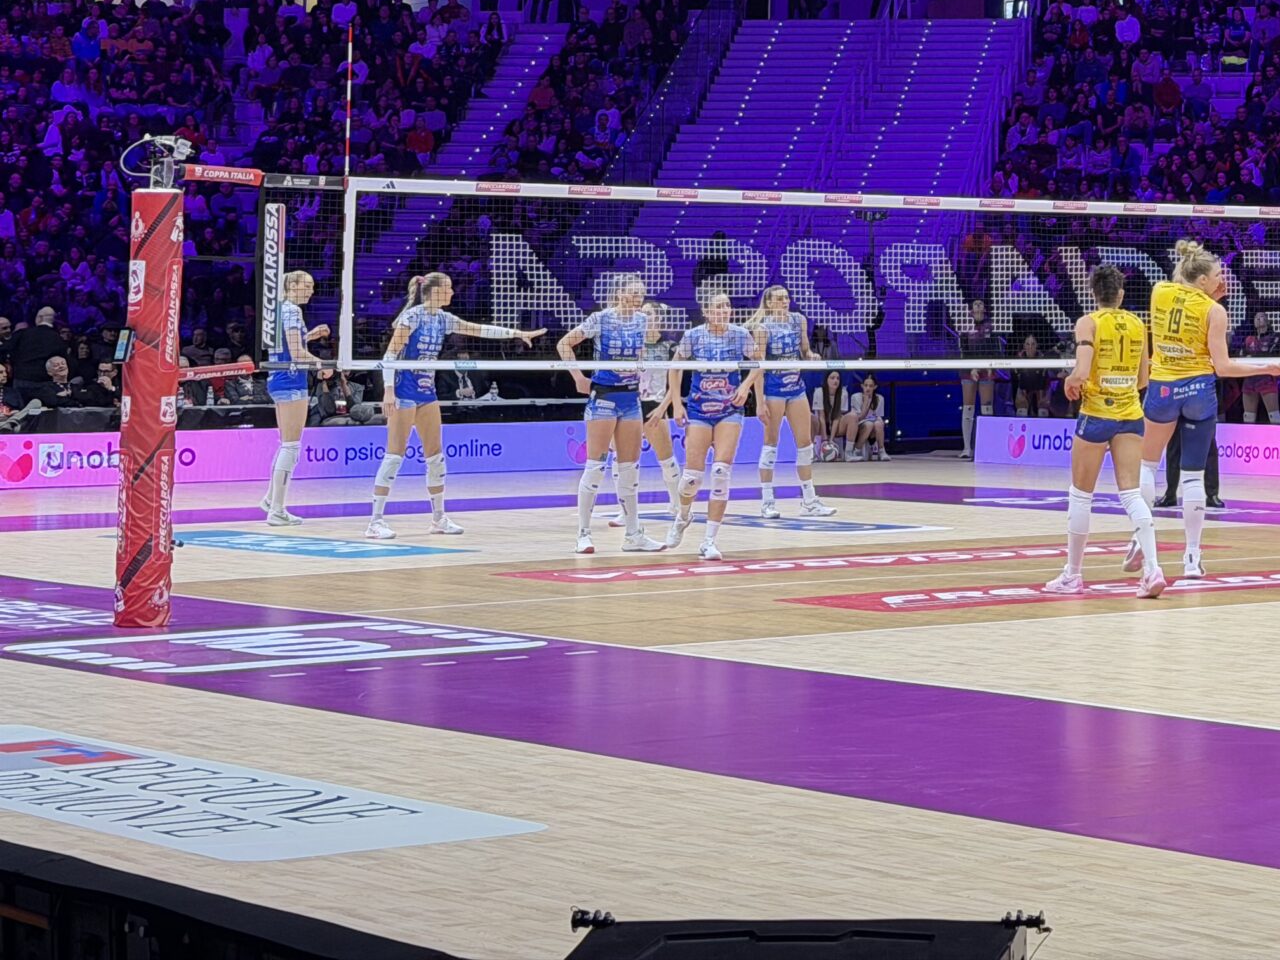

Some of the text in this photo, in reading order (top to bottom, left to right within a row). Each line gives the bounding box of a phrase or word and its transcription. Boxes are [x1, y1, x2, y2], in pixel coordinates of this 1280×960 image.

[204, 170, 254, 180] COPPA ITALIA
[263, 203, 279, 346] FRECCIAROSSA
[165, 264, 179, 363] FRECCIAROSSA
[1167, 307, 1183, 334] 19
[1118, 335, 1124, 362] 1
[305, 444, 338, 462] tuo
[446, 439, 502, 458] online
[1032, 429, 1072, 451] unob
[46, 441, 196, 470] unobo
[159, 455, 169, 554] FRECCIAROSSA
[57, 759, 422, 824] REGIONE
